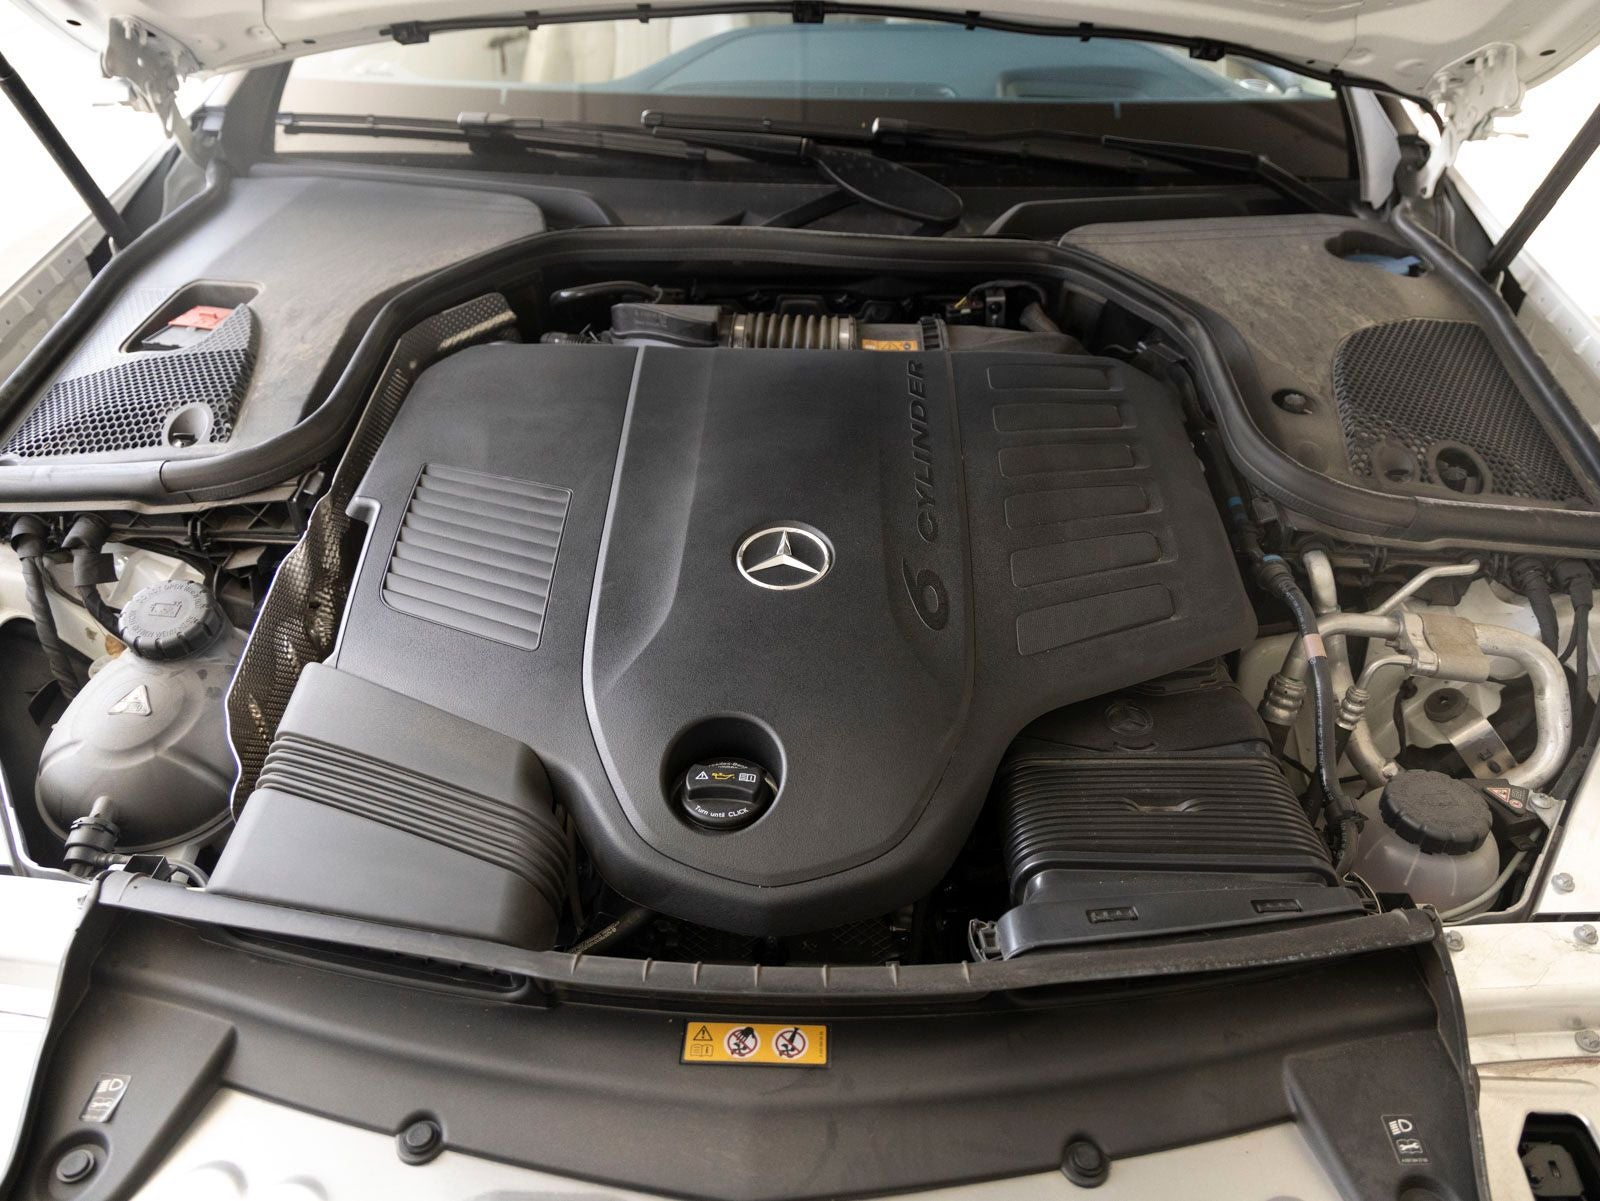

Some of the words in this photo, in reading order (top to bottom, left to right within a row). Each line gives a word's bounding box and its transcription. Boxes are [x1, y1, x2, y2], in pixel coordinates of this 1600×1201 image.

[907, 359, 938, 544] CYLINDER
[901, 556, 949, 632] 6
[695, 805, 708, 815] Turn
[728, 807, 748, 817] CLICK
